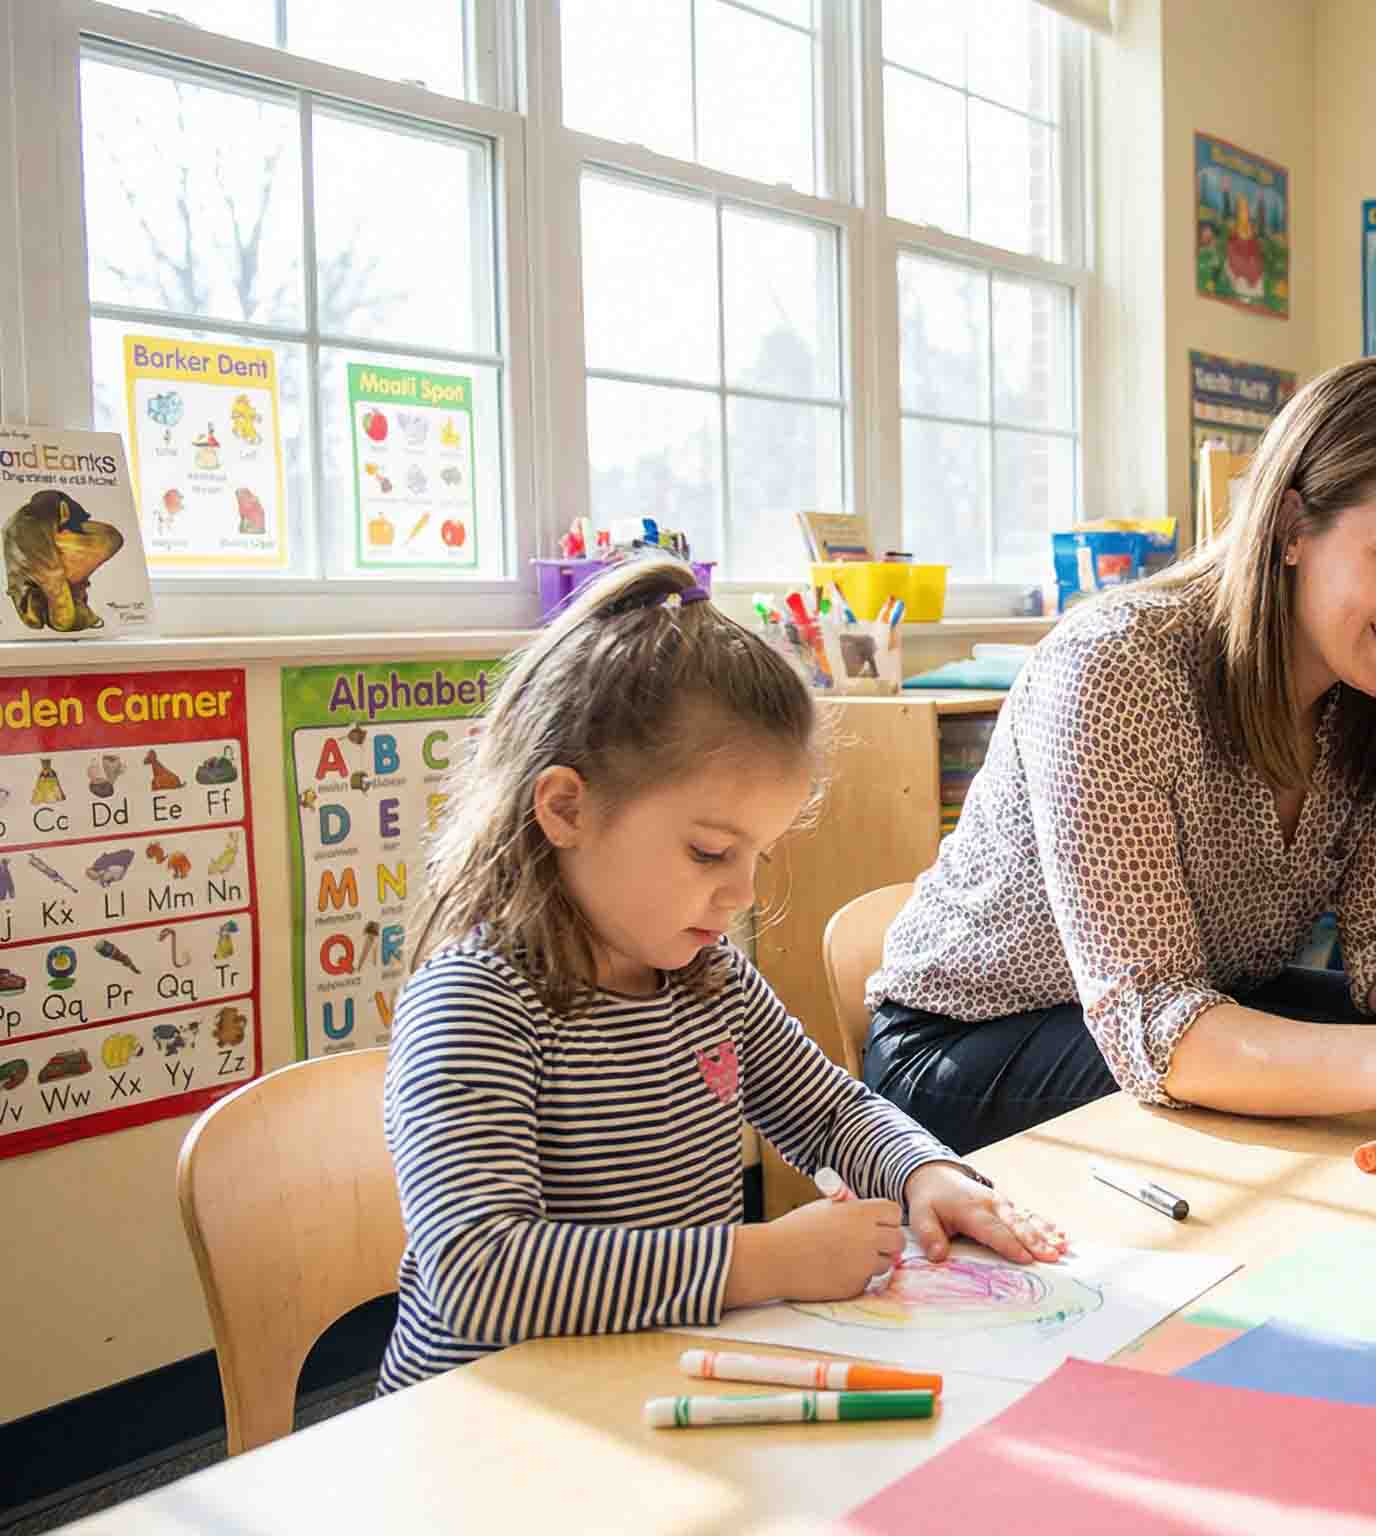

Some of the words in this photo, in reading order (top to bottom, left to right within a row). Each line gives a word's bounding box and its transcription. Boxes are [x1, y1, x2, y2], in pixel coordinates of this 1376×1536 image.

[133, 343, 211, 373] Barker
[0, 688, 84, 730] den
[328, 671, 489, 719] Alphabet
[315, 737, 349, 780] A
[373, 734, 401, 776] B
[422, 729, 450, 770] C
[33, 807, 70, 833] Cc
[92, 798, 129, 828] Dd
[153, 795, 183, 822] Ee
[206, 788, 232, 817] Ff
[319, 803, 351, 846] D
[379, 798, 401, 839] E
[42, 901, 75, 928] Kx
[104, 890, 126, 919] Ll
[148, 885, 195, 913] Mm
[208, 879, 241, 905] Nn
[318, 866, 359, 913] M
[376, 863, 407, 905] N
[319, 933, 355, 976] Q
[0, 1004, 22, 1037] p
[42, 994, 89, 1023] Qq
[157, 974, 198, 1001] Qq
[322, 997, 354, 1041] U
[41, 1085, 91, 1114] Ww
[110, 1071, 142, 1100] Xx
[165, 1061, 195, 1091] Yy
[217, 1050, 246, 1076] Zz
